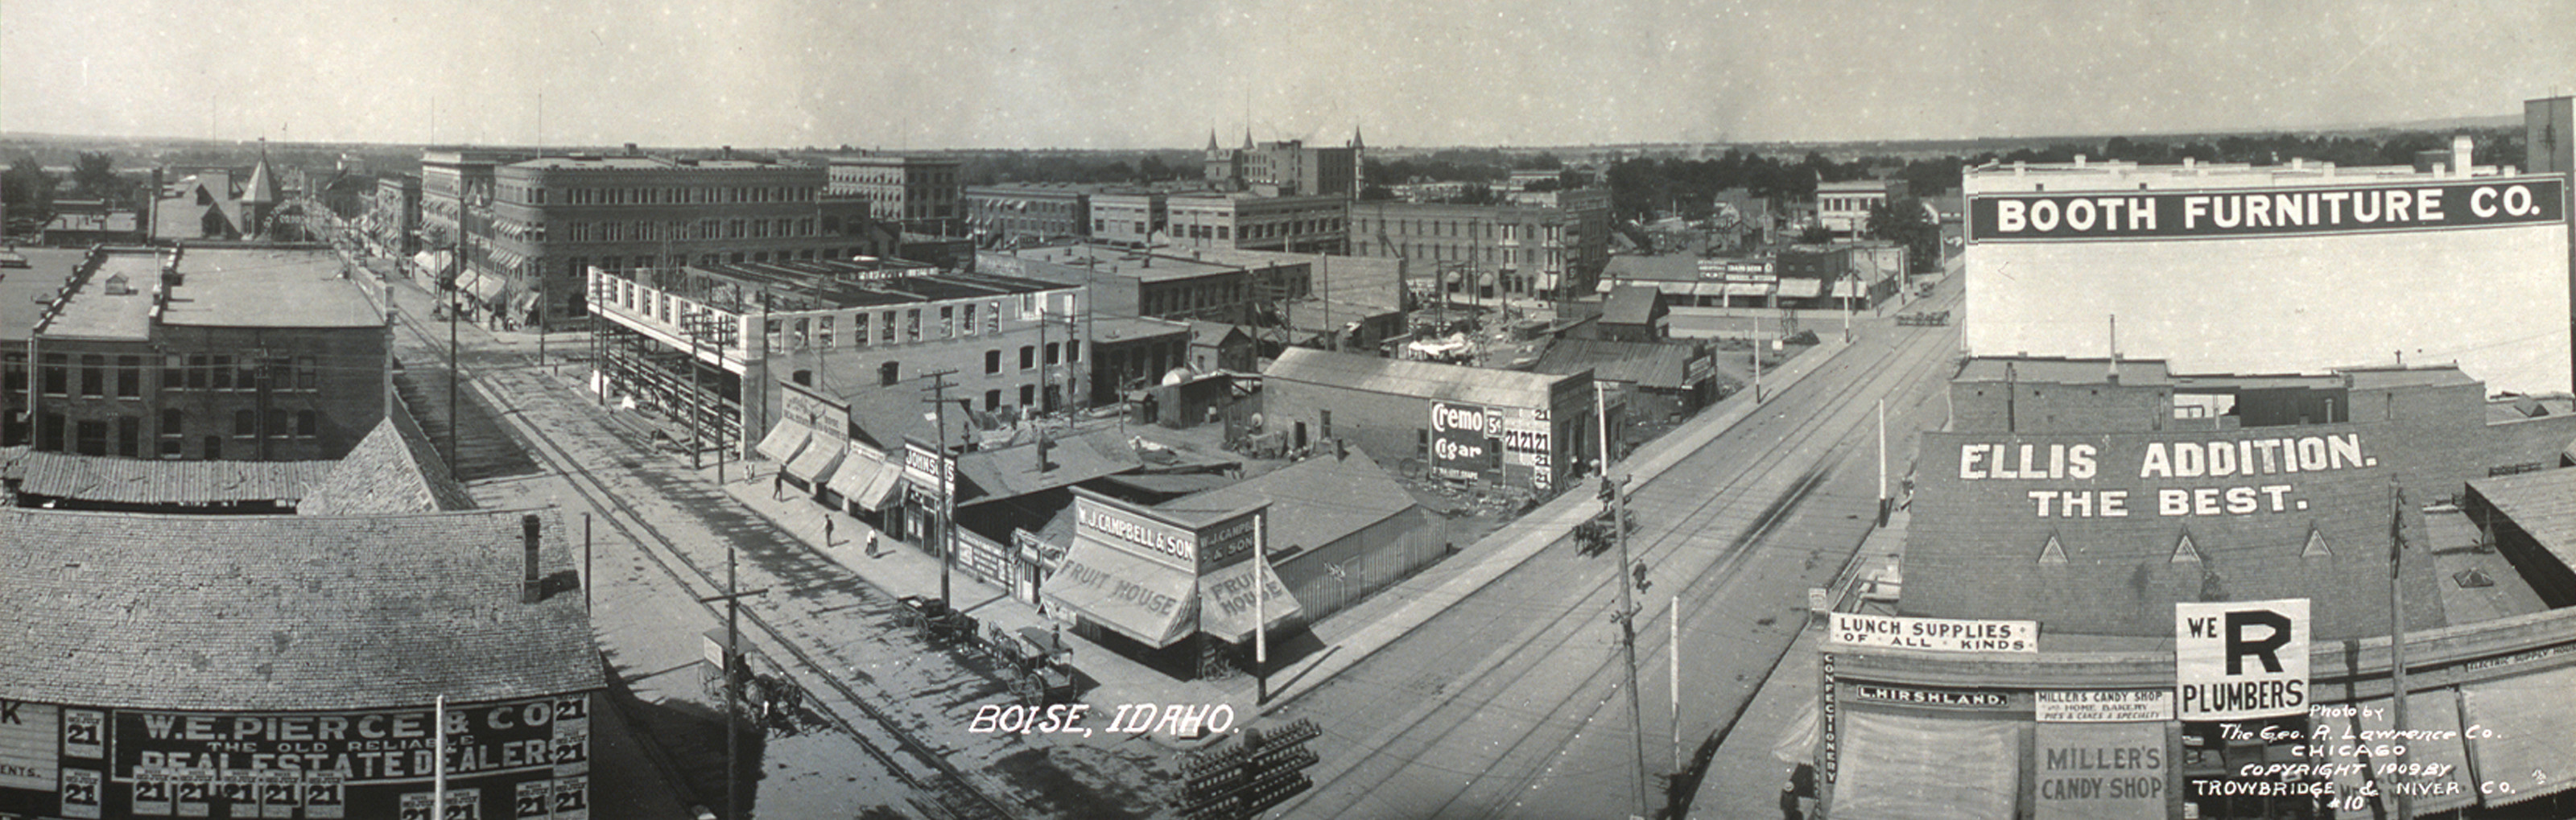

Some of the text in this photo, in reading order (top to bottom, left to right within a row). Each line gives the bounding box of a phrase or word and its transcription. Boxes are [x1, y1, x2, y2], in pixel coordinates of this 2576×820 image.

[1997, 185, 2541, 233] BOOTH FURNITURE CO.
[1432, 402, 1483, 432] Cremo
[1435, 438, 1482, 460] Cigar
[1959, 433, 2379, 480] ELLIS ADDITION.
[2028, 484, 2310, 517] THE BEST.
[1062, 559, 1177, 616] FRUIT HOUSE
[1840, 617, 2012, 638] LUNCH SUPPLIES
[1843, 633, 2025, 651] OF ALL KINDS
[2187, 609, 2292, 675] WE R
[2038, 690, 2162, 703] MILLER'S CANDY SHOP
[2183, 679, 2304, 713] PLUMBERS
[555, 699, 587, 721] 21
[1824, 654, 1835, 782] CONFECTIONERY
[68, 724, 100, 746] 21
[207, 741, 257, 753] THE
[278, 741, 327, 753] OLD
[555, 743, 587, 765] 21
[2047, 747, 2161, 771] MILLER'S
[65, 783, 98, 806] 21
[136, 780, 169, 802] 21
[180, 781, 209, 804] 21
[224, 783, 257, 804] 21
[266, 784, 299, 805] 21
[308, 784, 342, 806] 21
[2041, 777, 2162, 800] CANDY SHOP
[445, 804, 475, 820] 21
[518, 797, 550, 818] 21
[555, 790, 587, 814] 21
